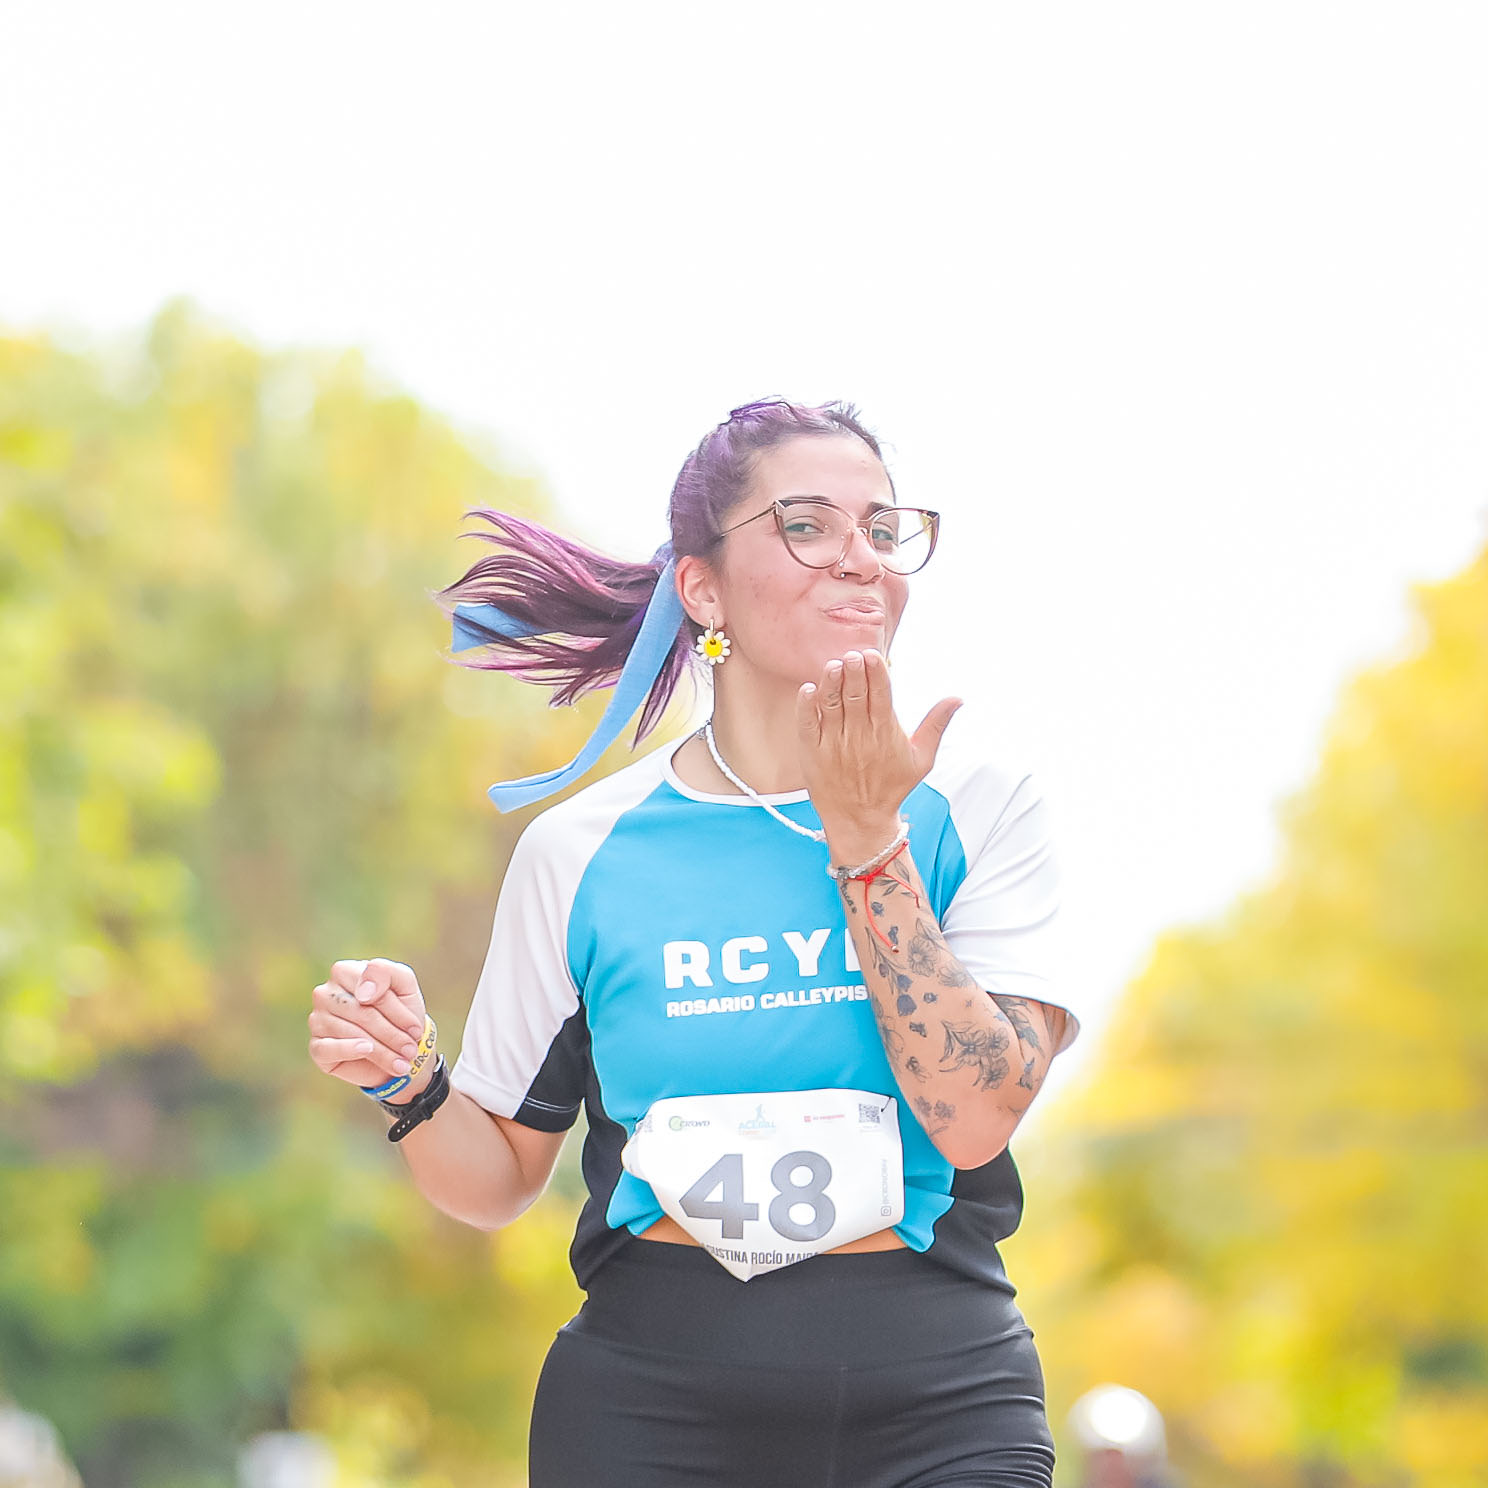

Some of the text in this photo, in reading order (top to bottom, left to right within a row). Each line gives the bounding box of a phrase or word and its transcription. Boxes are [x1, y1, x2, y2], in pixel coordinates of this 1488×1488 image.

[666, 995, 755, 1018] ROSARIO
[679, 1150, 836, 1242] 48
[751, 1250, 783, 1265] ROCÍO
